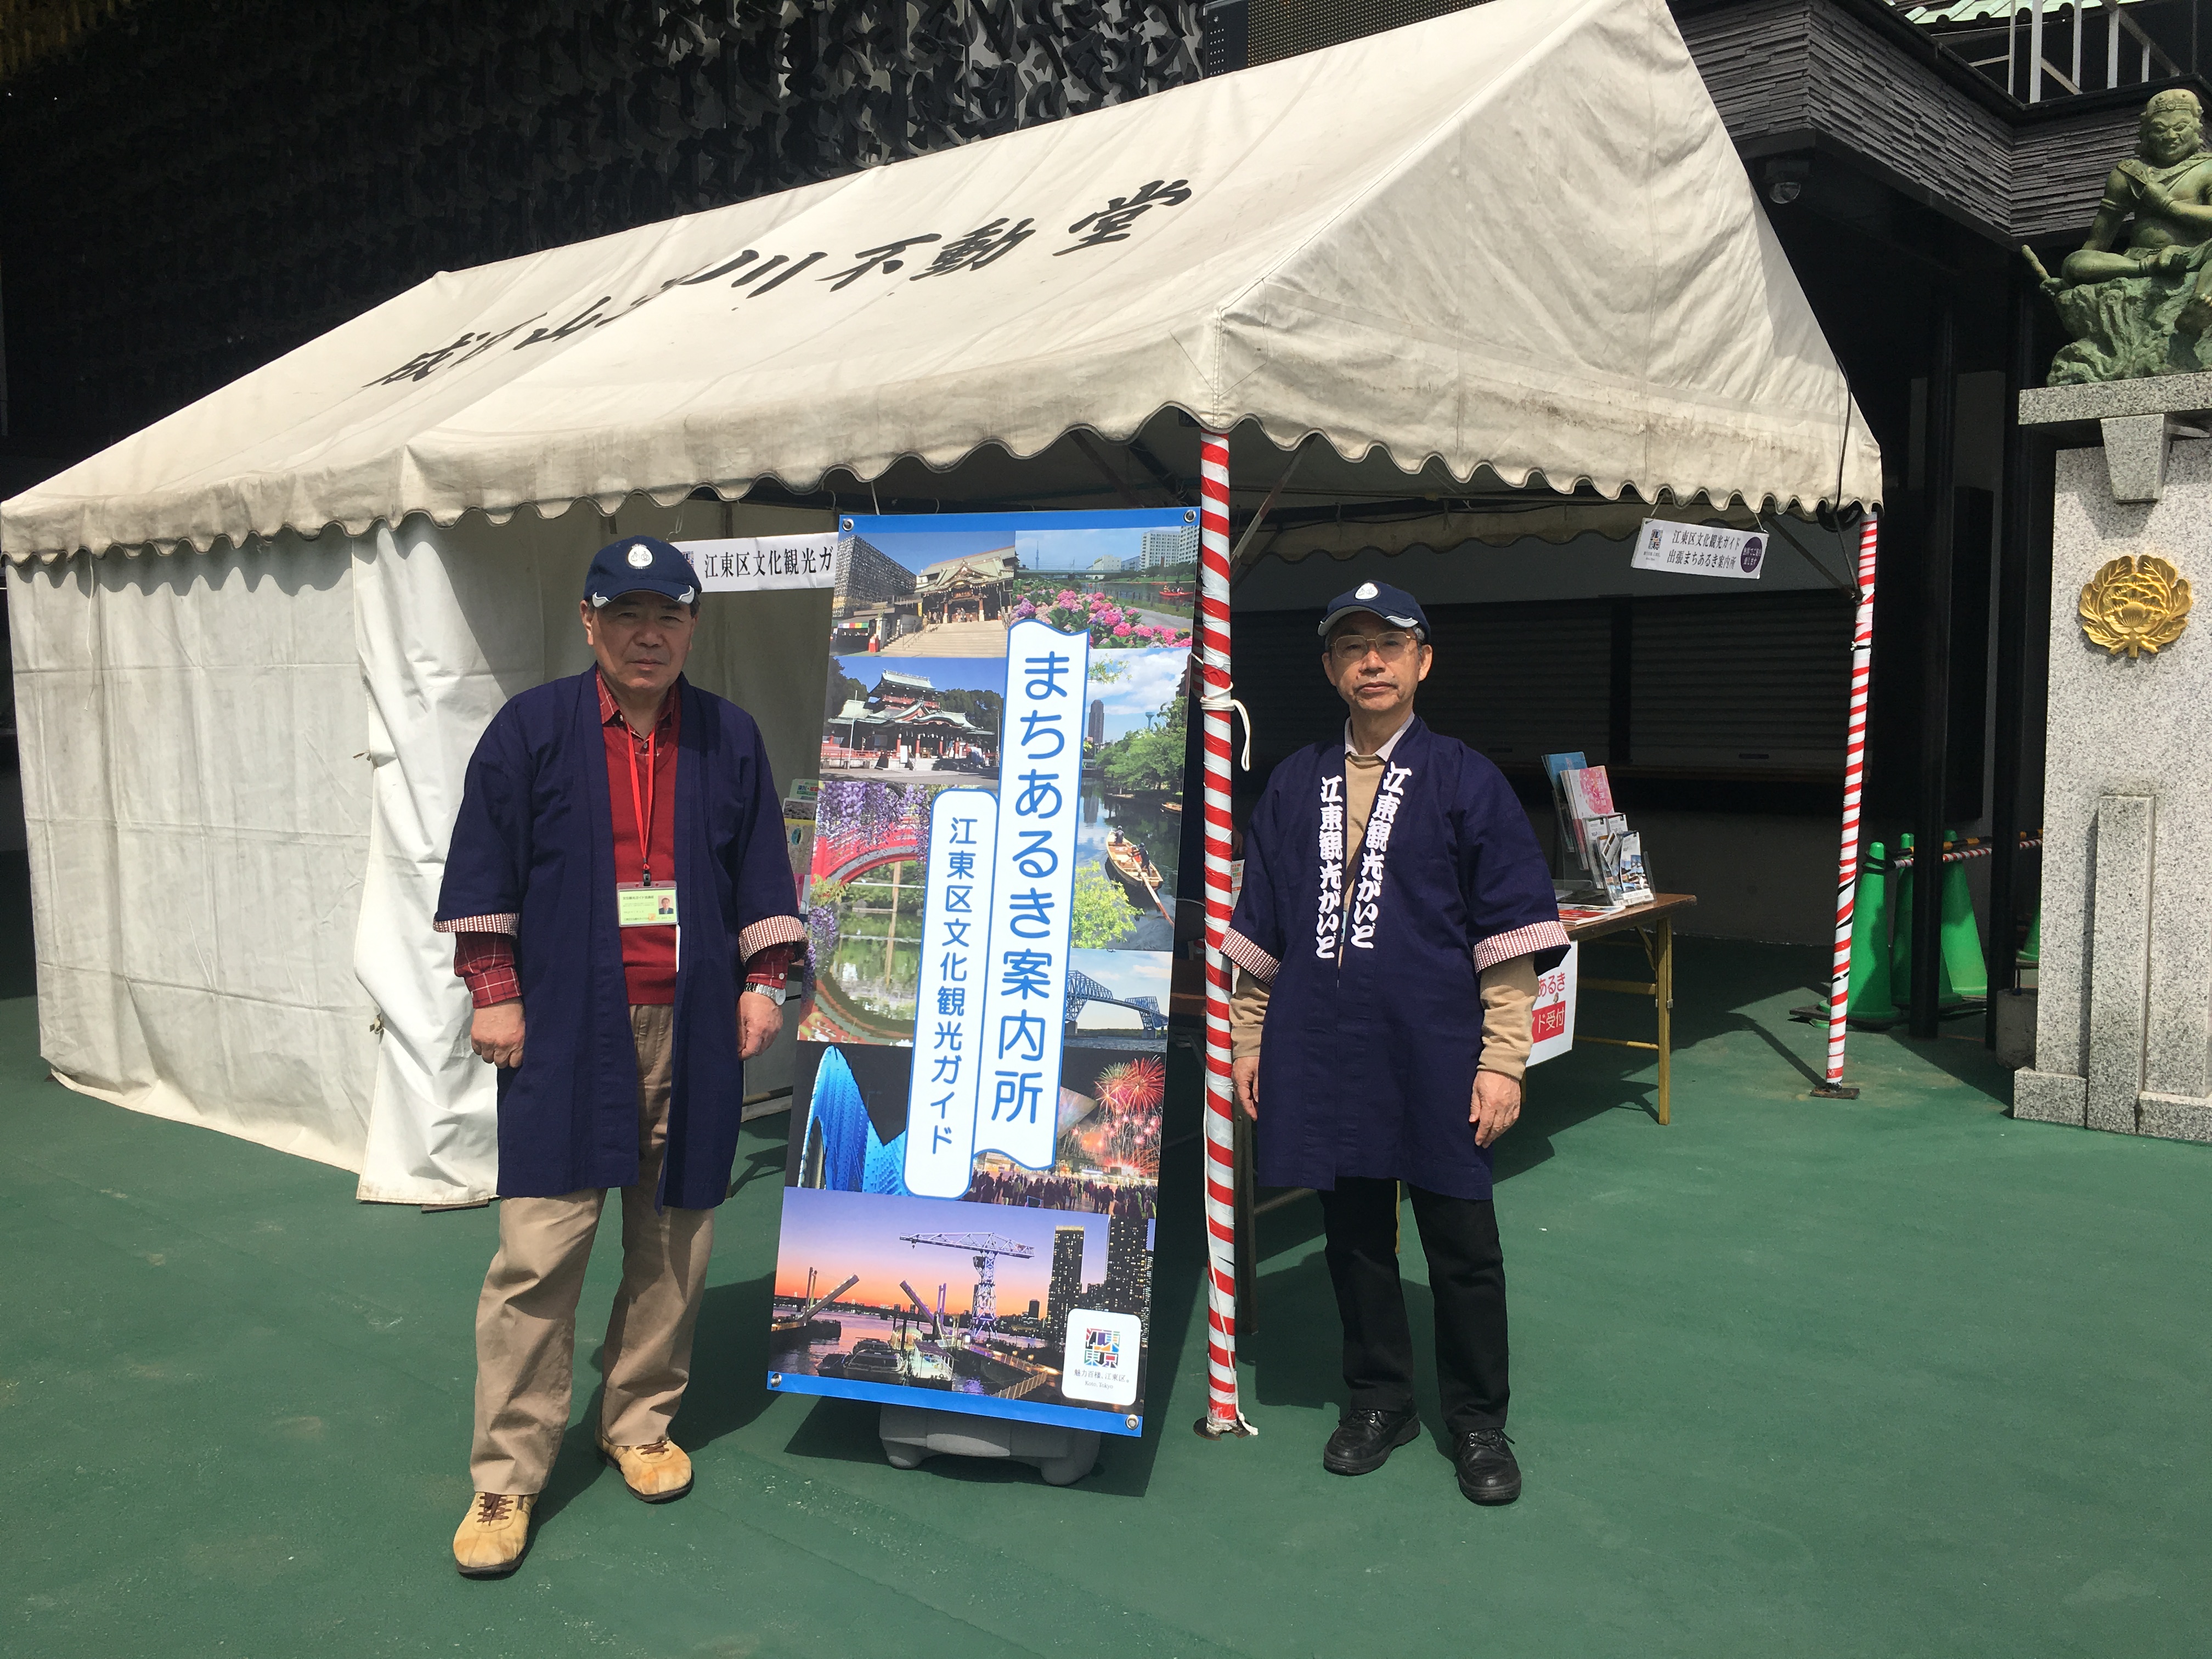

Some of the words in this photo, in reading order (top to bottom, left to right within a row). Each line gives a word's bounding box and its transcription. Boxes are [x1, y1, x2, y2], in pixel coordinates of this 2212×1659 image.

[704, 546, 833, 578] 江東区文化観光ガ
[1667, 549, 1736, 569] 出張まちあるき案内所
[1672, 530, 1741, 550] 江東区文化観光ガイド
[991, 651, 1070, 1124] まちあるき案内所
[1316, 775, 1343, 958] 江東観光がいど
[1351, 761, 1412, 949] 江東観光がいど
[930, 816, 978, 1154] 江東区文化観光ガイド
